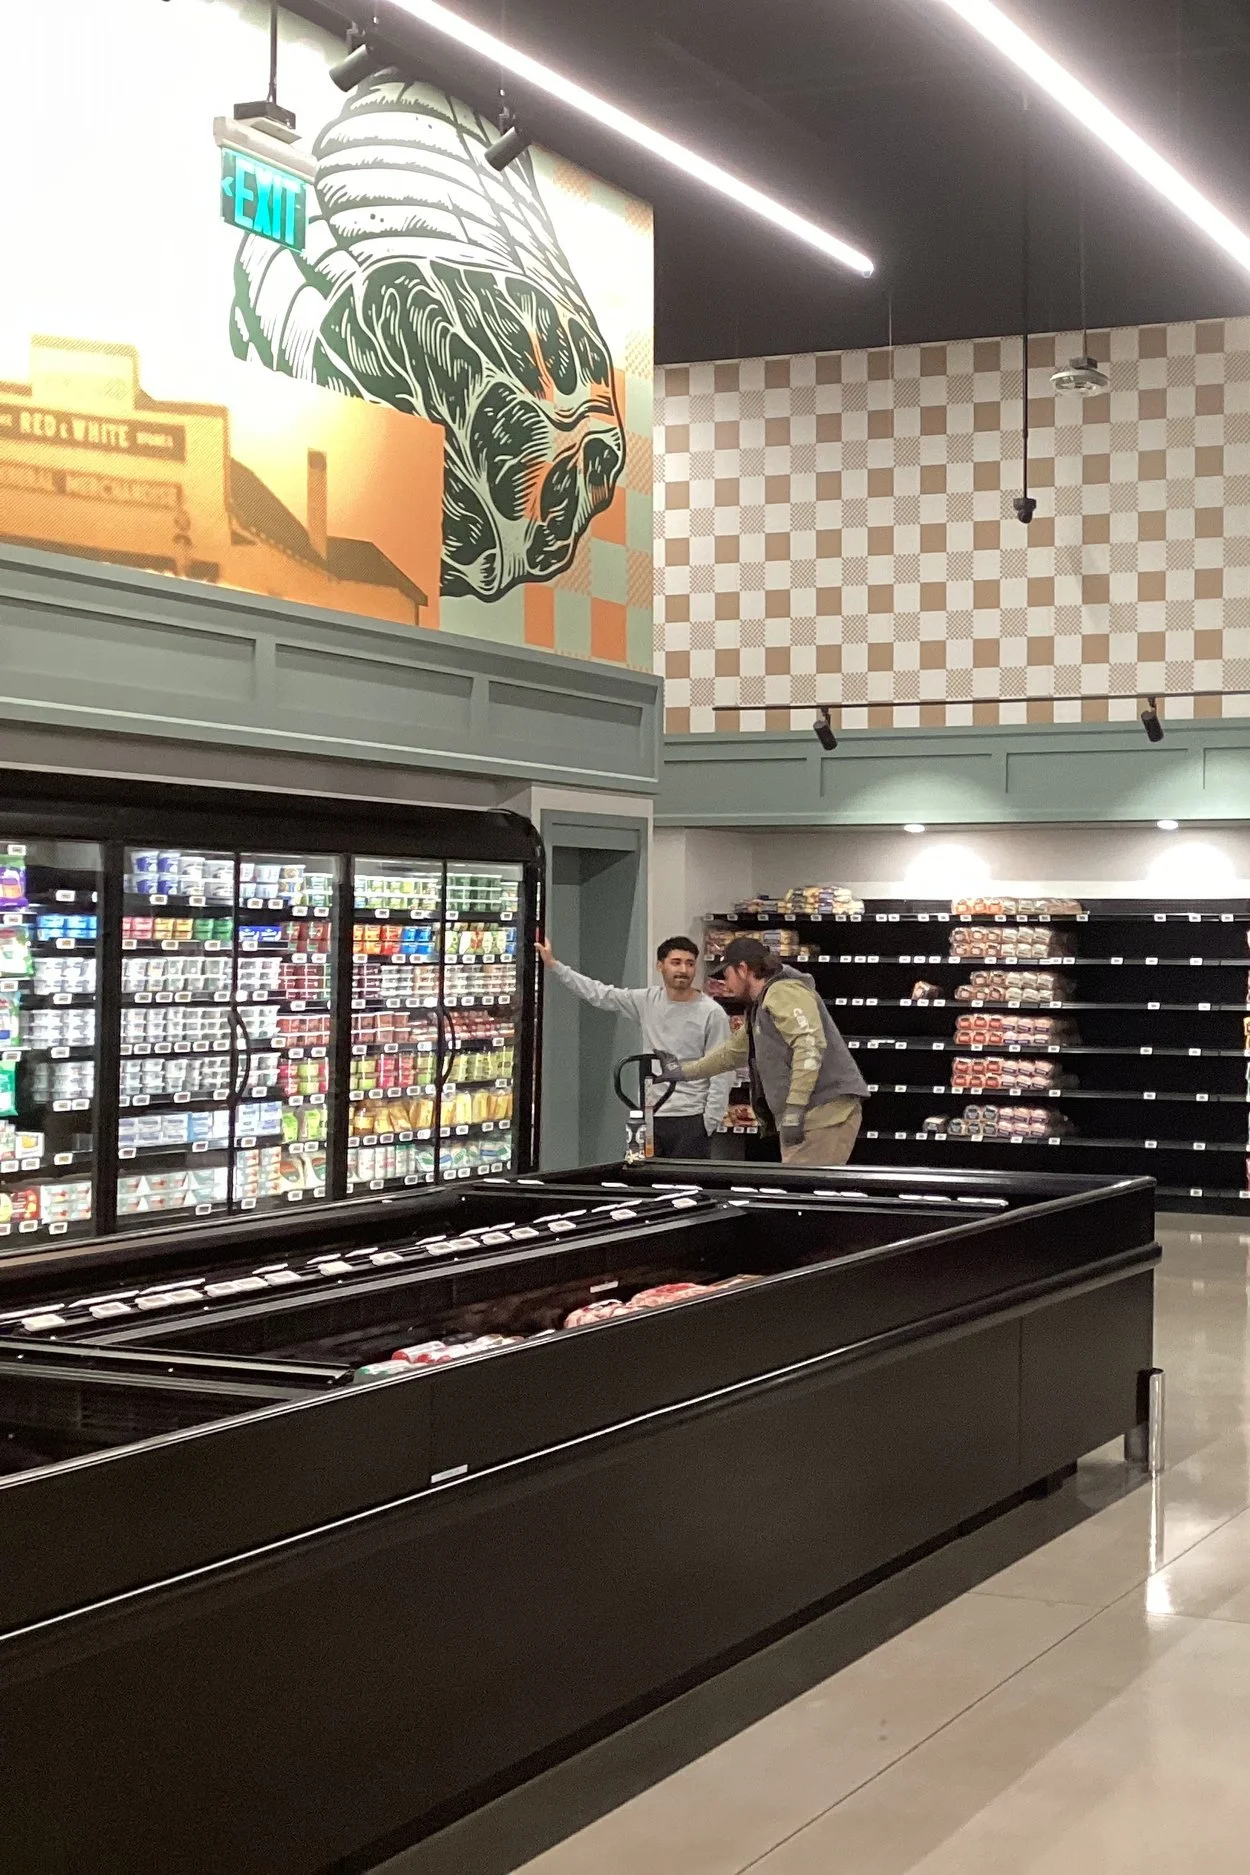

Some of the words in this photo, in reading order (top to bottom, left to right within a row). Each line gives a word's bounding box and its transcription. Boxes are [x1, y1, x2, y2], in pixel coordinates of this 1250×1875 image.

[234, 158, 299, 246] EXIT
[20, 411, 57, 437] RED
[71, 417, 130, 449] WHITE
